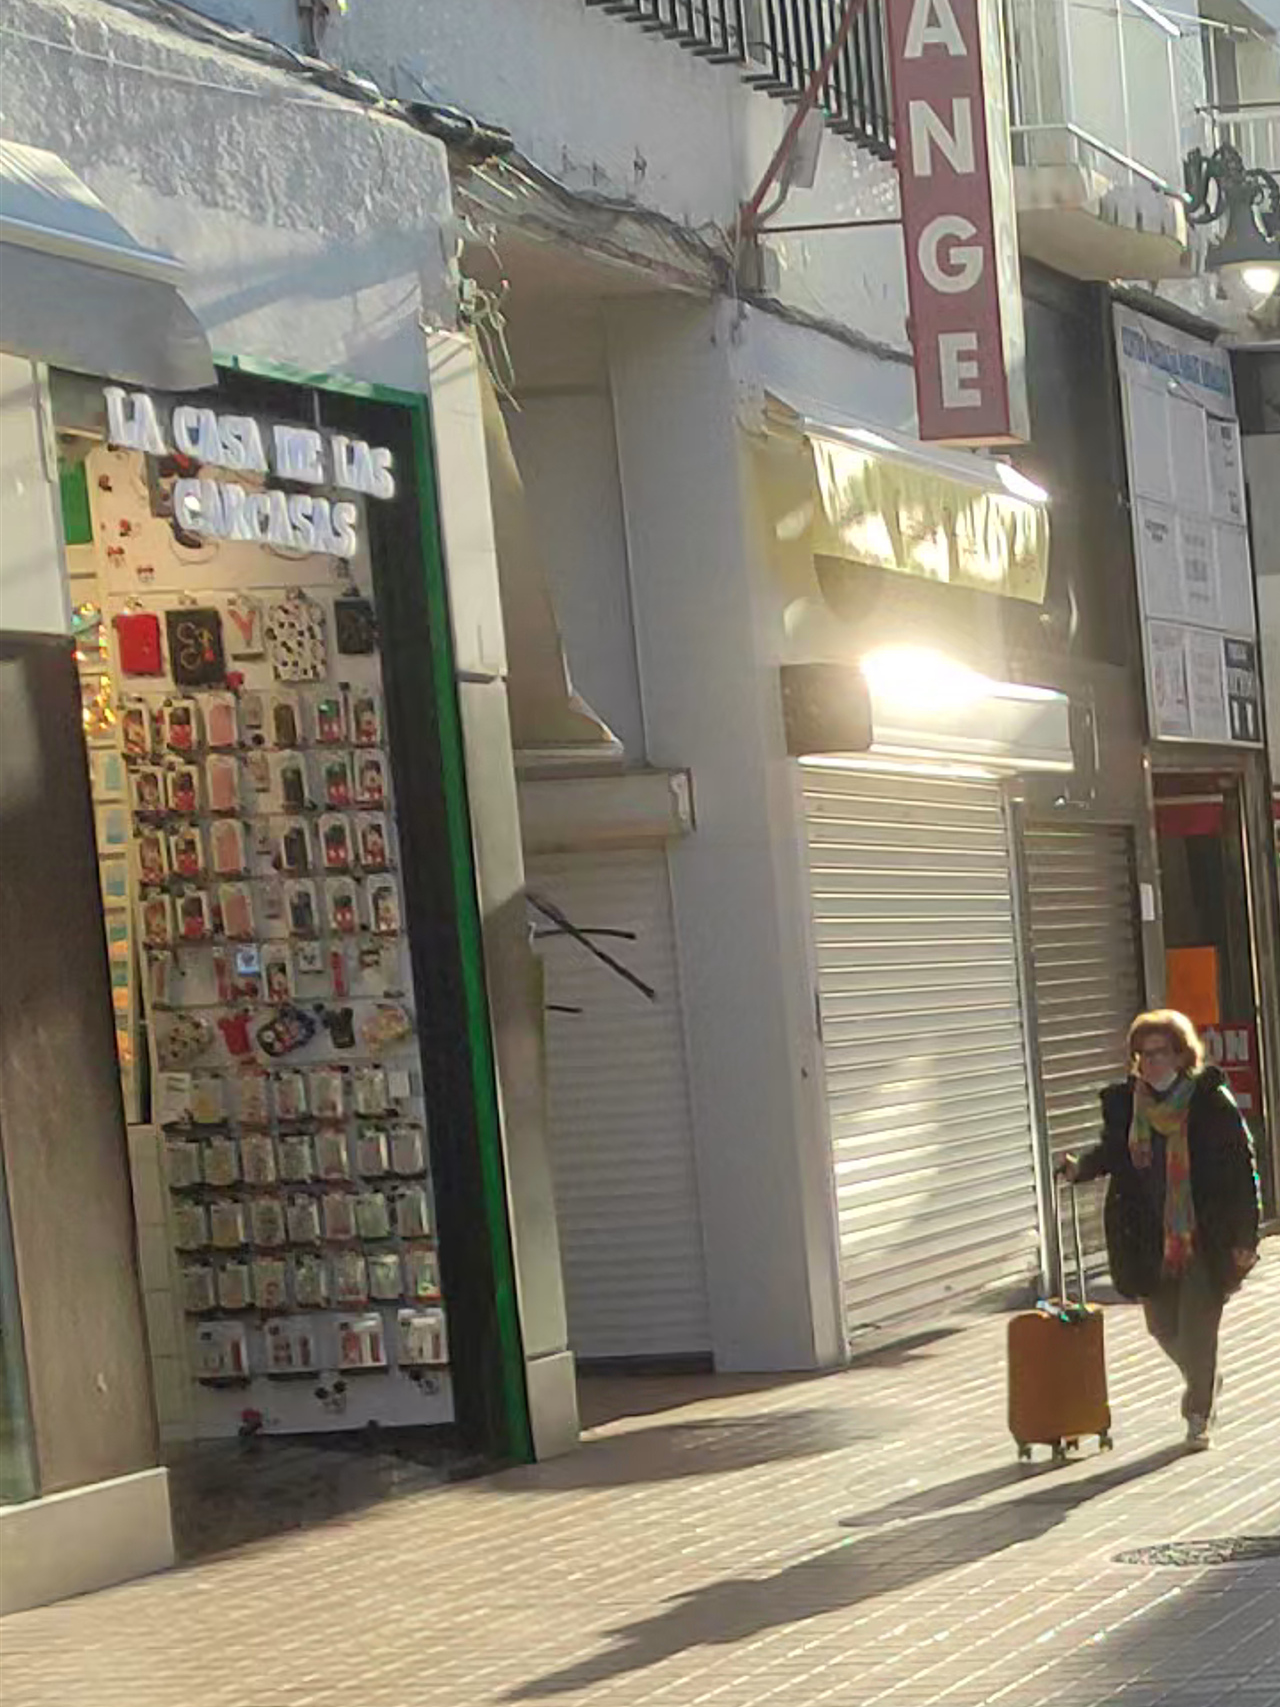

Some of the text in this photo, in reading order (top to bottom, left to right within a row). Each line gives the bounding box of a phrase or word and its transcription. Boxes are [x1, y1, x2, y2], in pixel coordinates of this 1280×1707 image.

[103, 386, 395, 500] LA CASA DE LAS
[173, 477, 357, 560] CARCASAS
